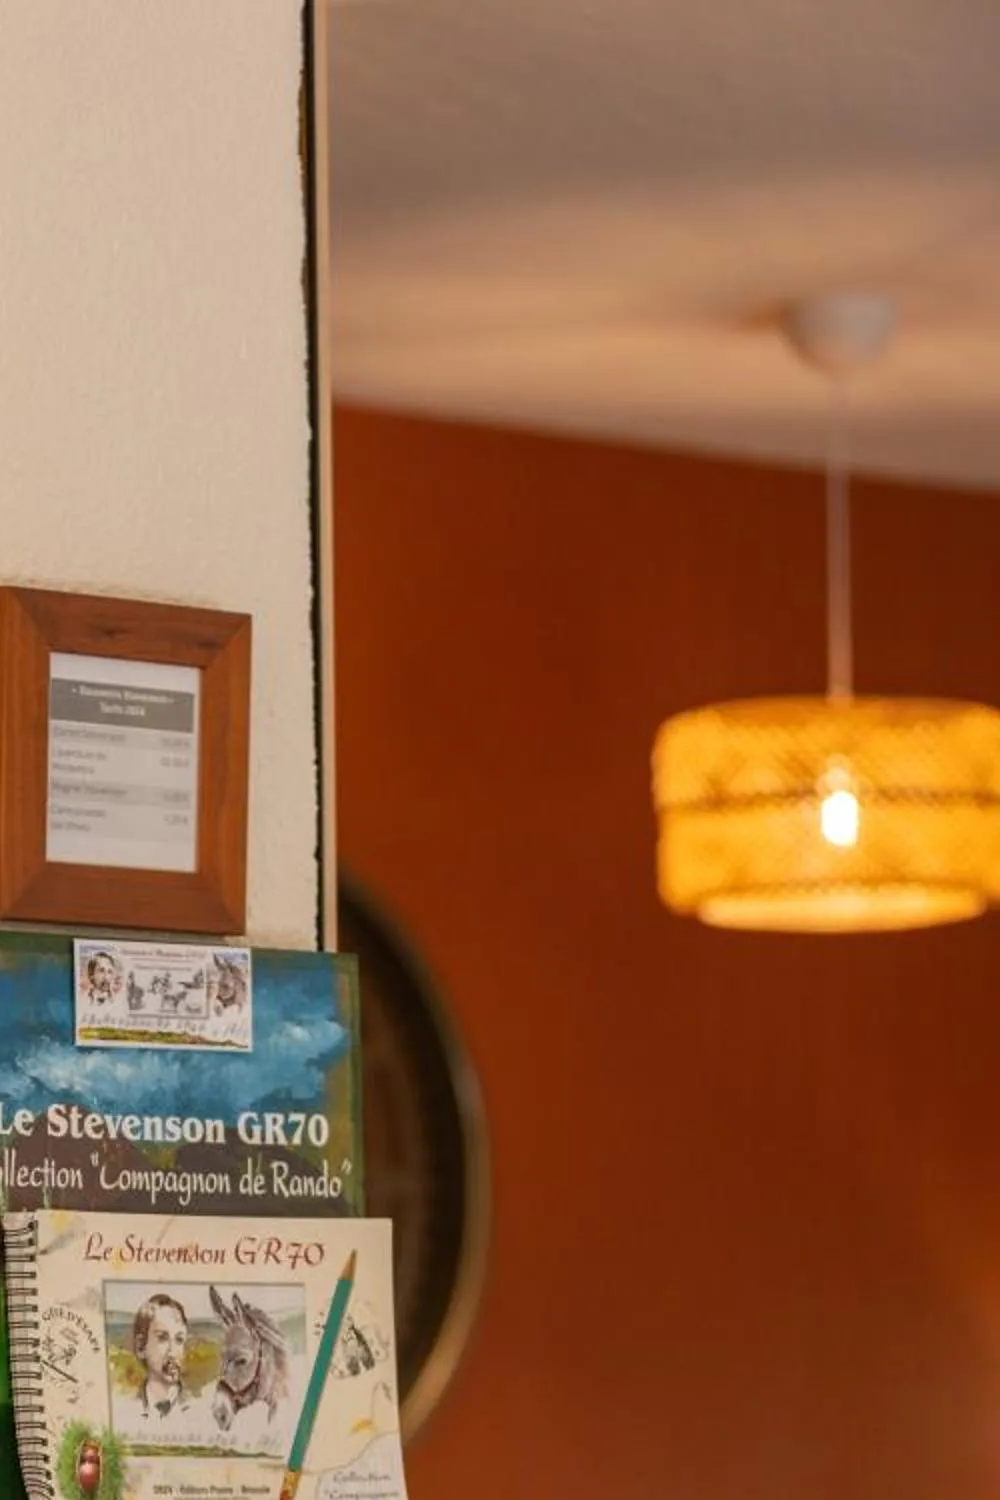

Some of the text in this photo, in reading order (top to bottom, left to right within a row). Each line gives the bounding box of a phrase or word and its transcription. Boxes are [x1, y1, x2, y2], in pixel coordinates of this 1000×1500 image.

[47, 1103, 226, 1144] Stevenson
[237, 1111, 329, 1147] GR70
[239, 1156, 265, 1196] de
[83, 1231, 114, 1263] Le
[119, 1233, 227, 1265] Stevenson
